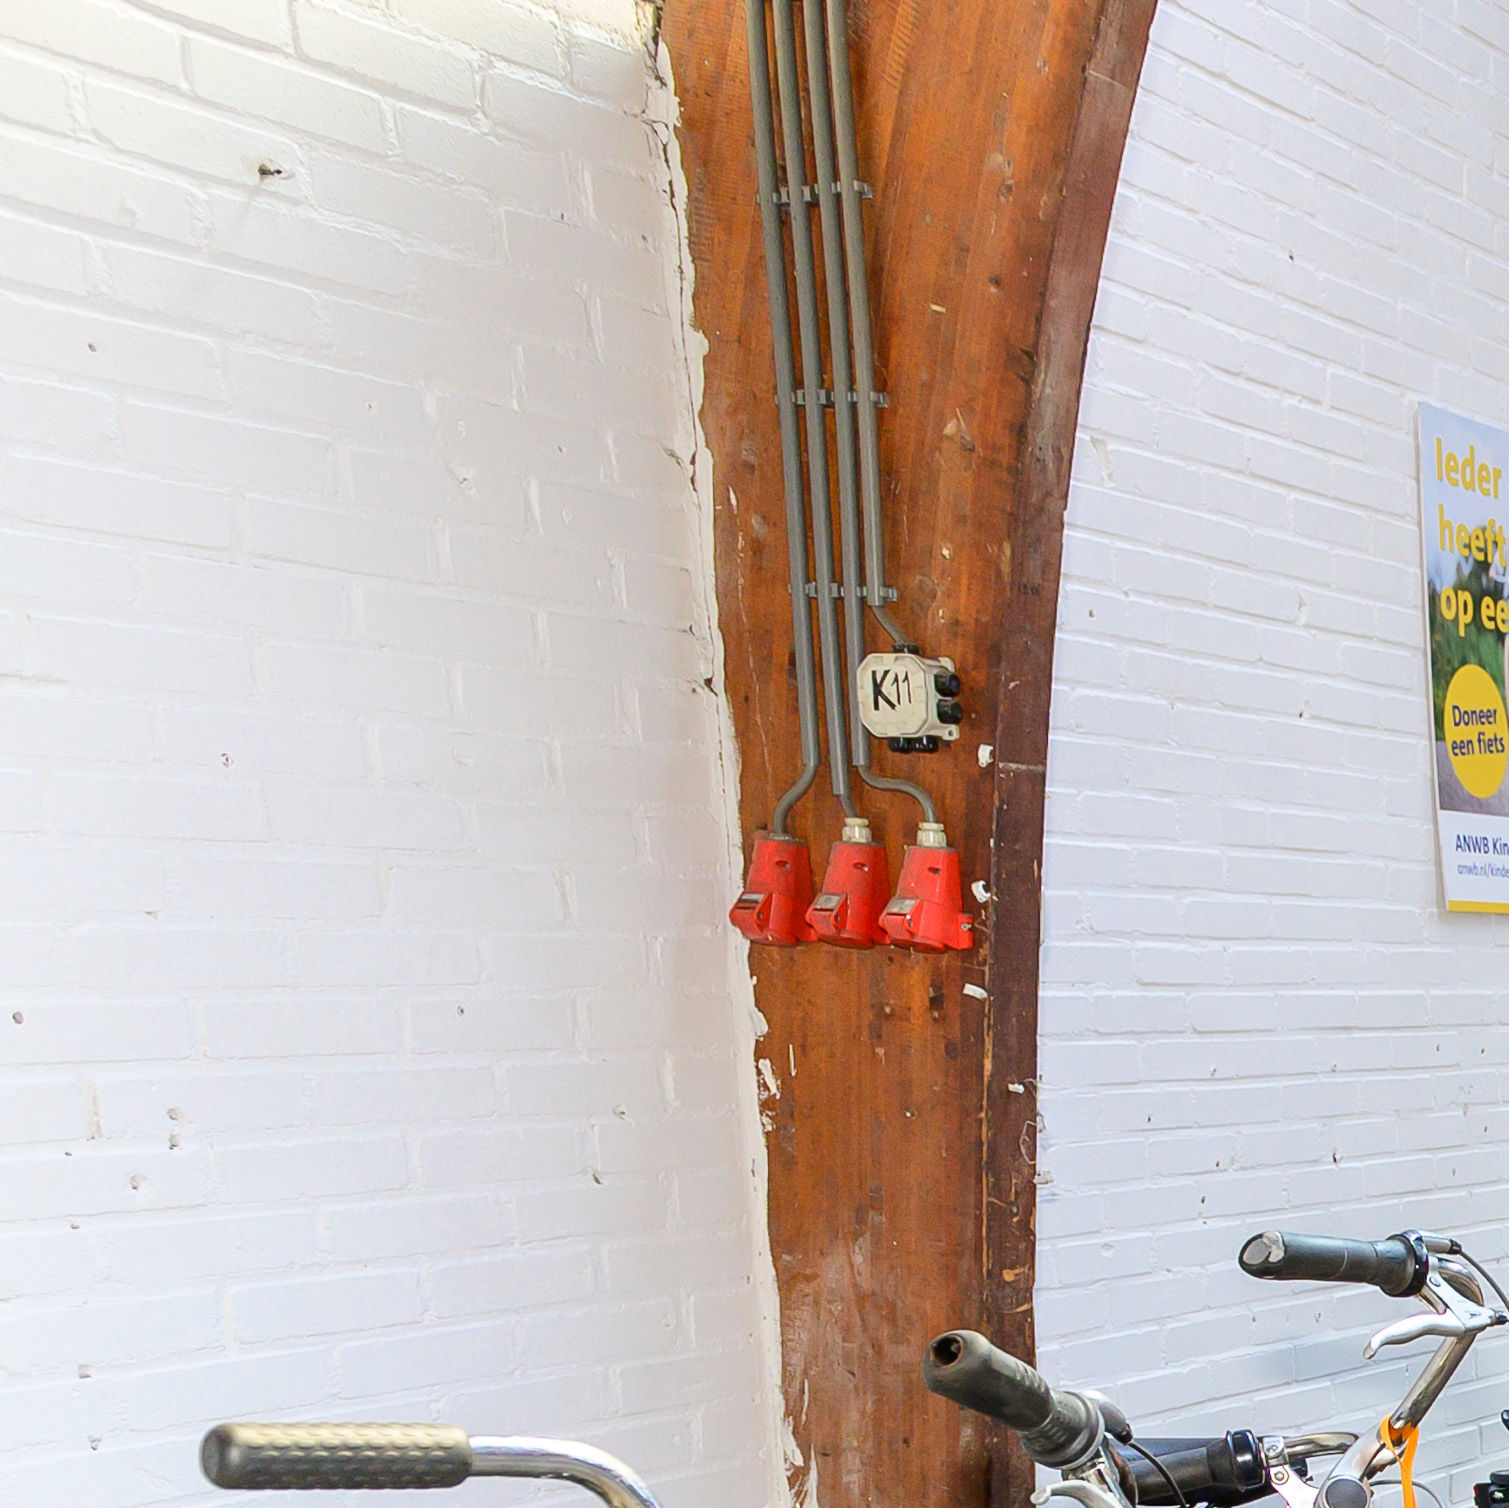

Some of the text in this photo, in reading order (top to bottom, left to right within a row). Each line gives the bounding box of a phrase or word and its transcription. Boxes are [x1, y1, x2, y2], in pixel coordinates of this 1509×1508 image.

[1436, 437, 1502, 499] Ieder
[1438, 503, 1507, 567] heeft
[1440, 586, 1474, 637] op
[871, 669, 912, 711] K11
[1452, 705, 1497, 727] Doneer
[1451, 731, 1505, 756] een fiets
[1455, 834, 1490, 854] ANWB
